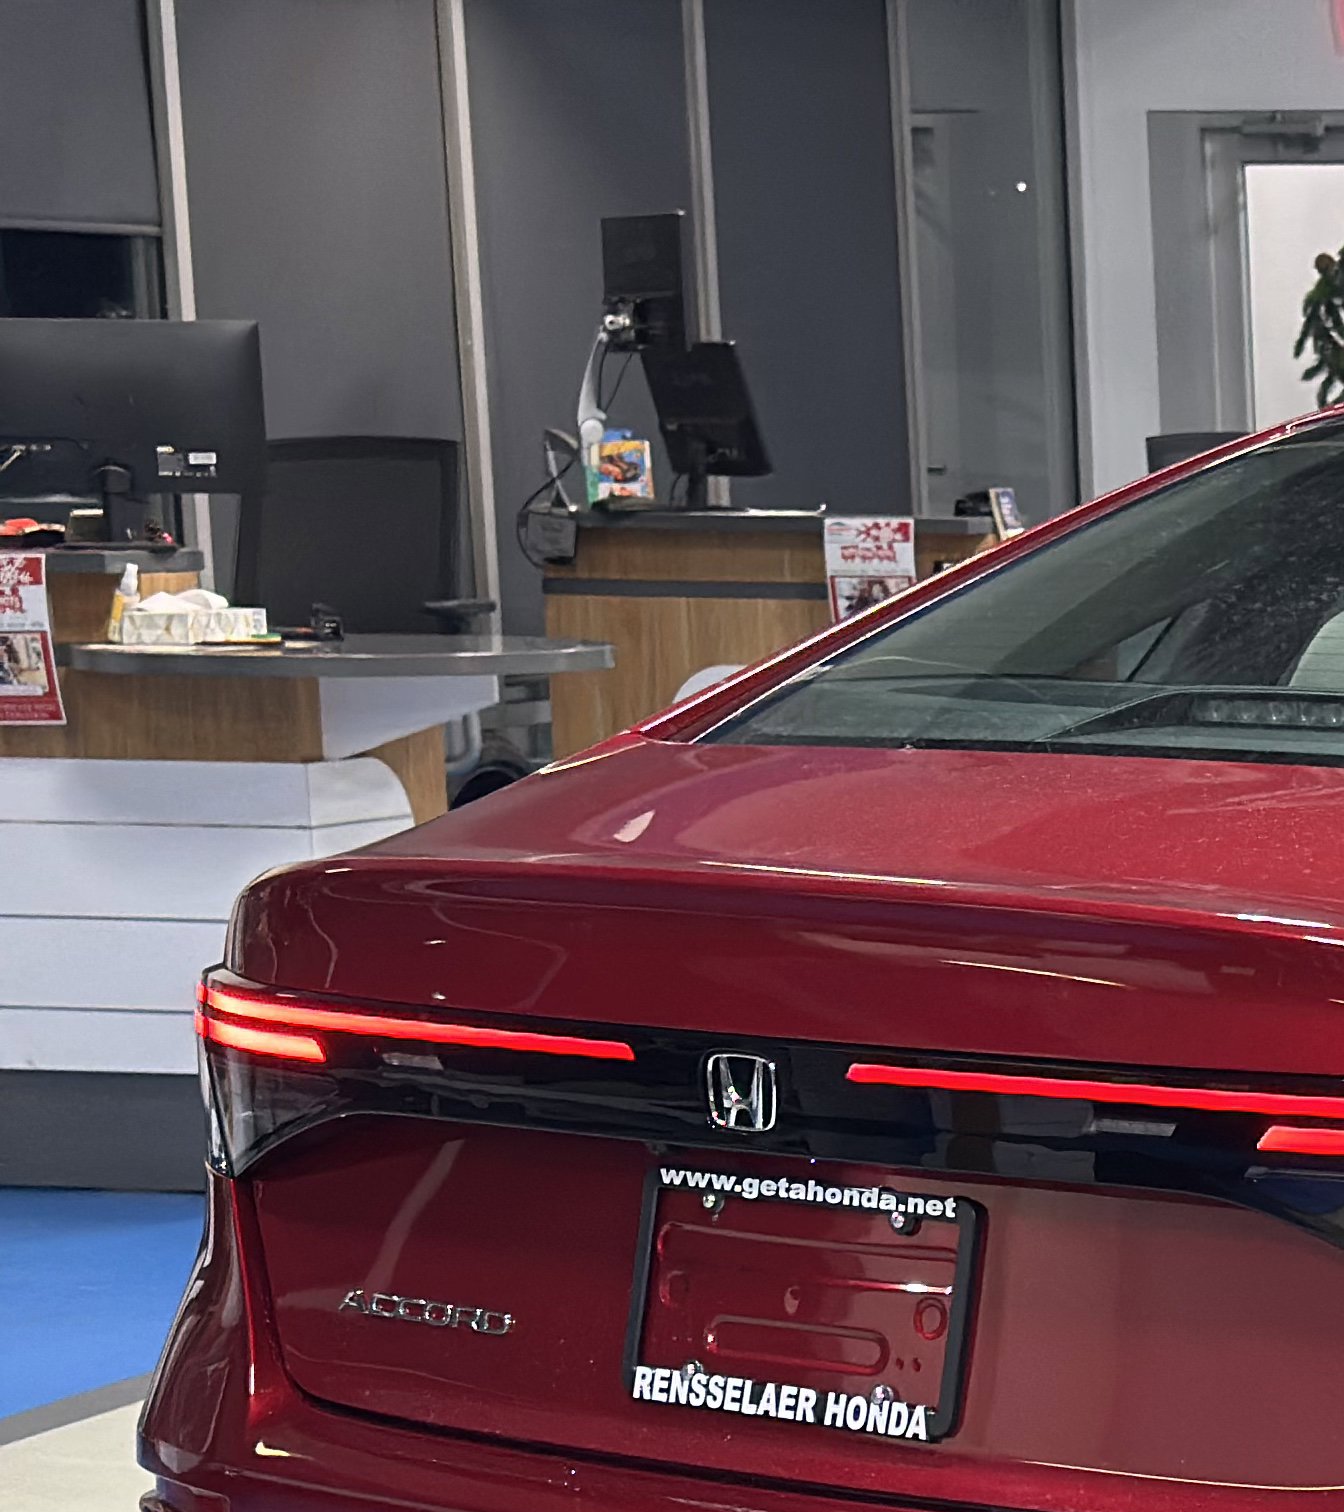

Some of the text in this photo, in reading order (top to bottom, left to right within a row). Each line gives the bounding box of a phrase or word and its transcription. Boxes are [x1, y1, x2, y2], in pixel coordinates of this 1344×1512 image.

[659, 1166, 957, 1218] www.getahonda.net
[338, 1289, 513, 1335] ACCORD
[632, 1365, 929, 1441] RENSSELAER HONDA
